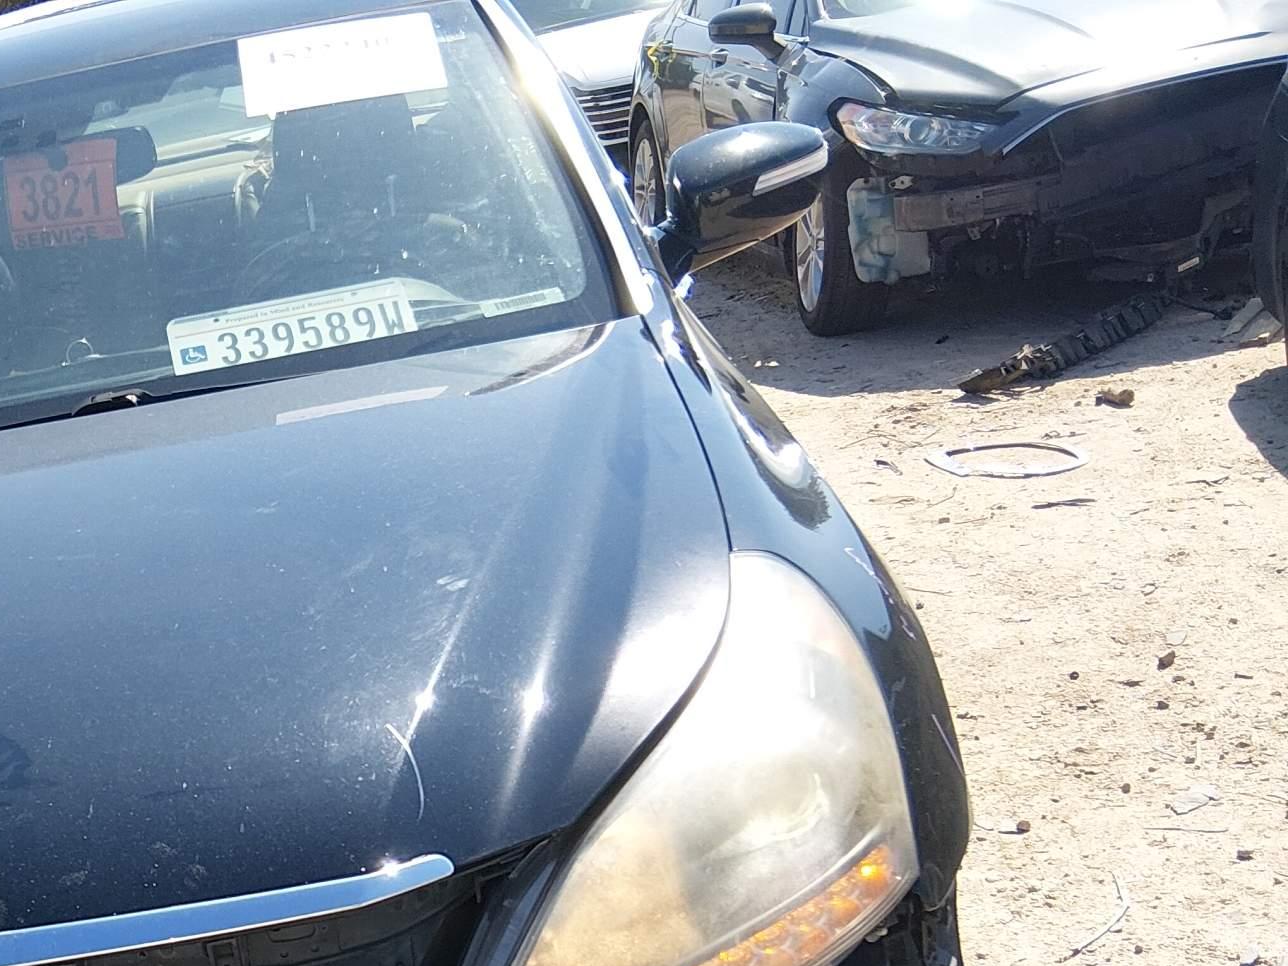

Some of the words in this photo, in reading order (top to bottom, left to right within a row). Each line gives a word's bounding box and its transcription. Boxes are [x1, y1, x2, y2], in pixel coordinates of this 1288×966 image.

[20, 168, 100, 222] 3821
[14, 226, 97, 249] SERVICE
[217, 299, 406, 365] 339589W
